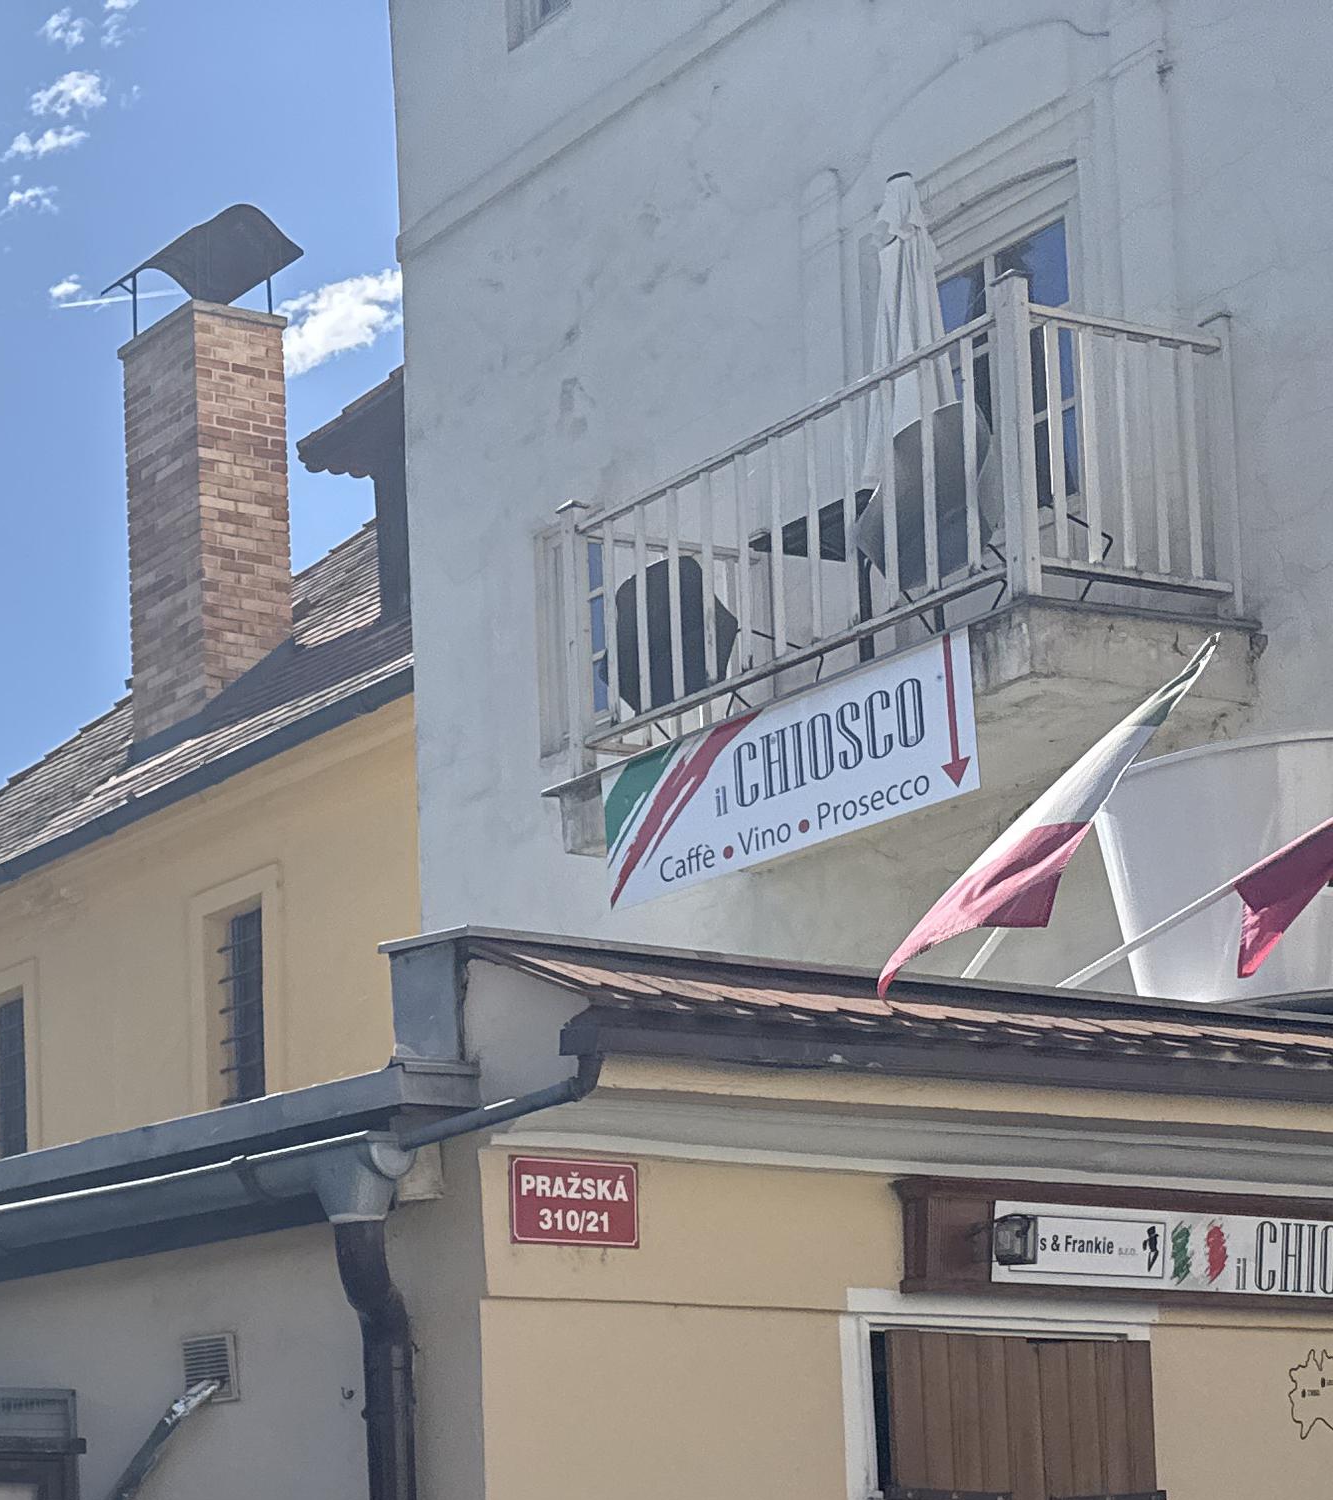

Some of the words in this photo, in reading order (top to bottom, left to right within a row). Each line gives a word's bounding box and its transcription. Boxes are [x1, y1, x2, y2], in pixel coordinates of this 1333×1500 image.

[716, 786, 728, 817] il
[733, 678, 925, 808] CHIOSCO
[660, 844, 715, 882] Caffè
[738, 823, 791, 855] Vino
[817, 775, 930, 830] Prosecco
[520, 1171, 629, 1202] PRAŽSKÁ
[539, 1208, 609, 1234] 310/21
[1065, 1235, 1114, 1255] Frankie
